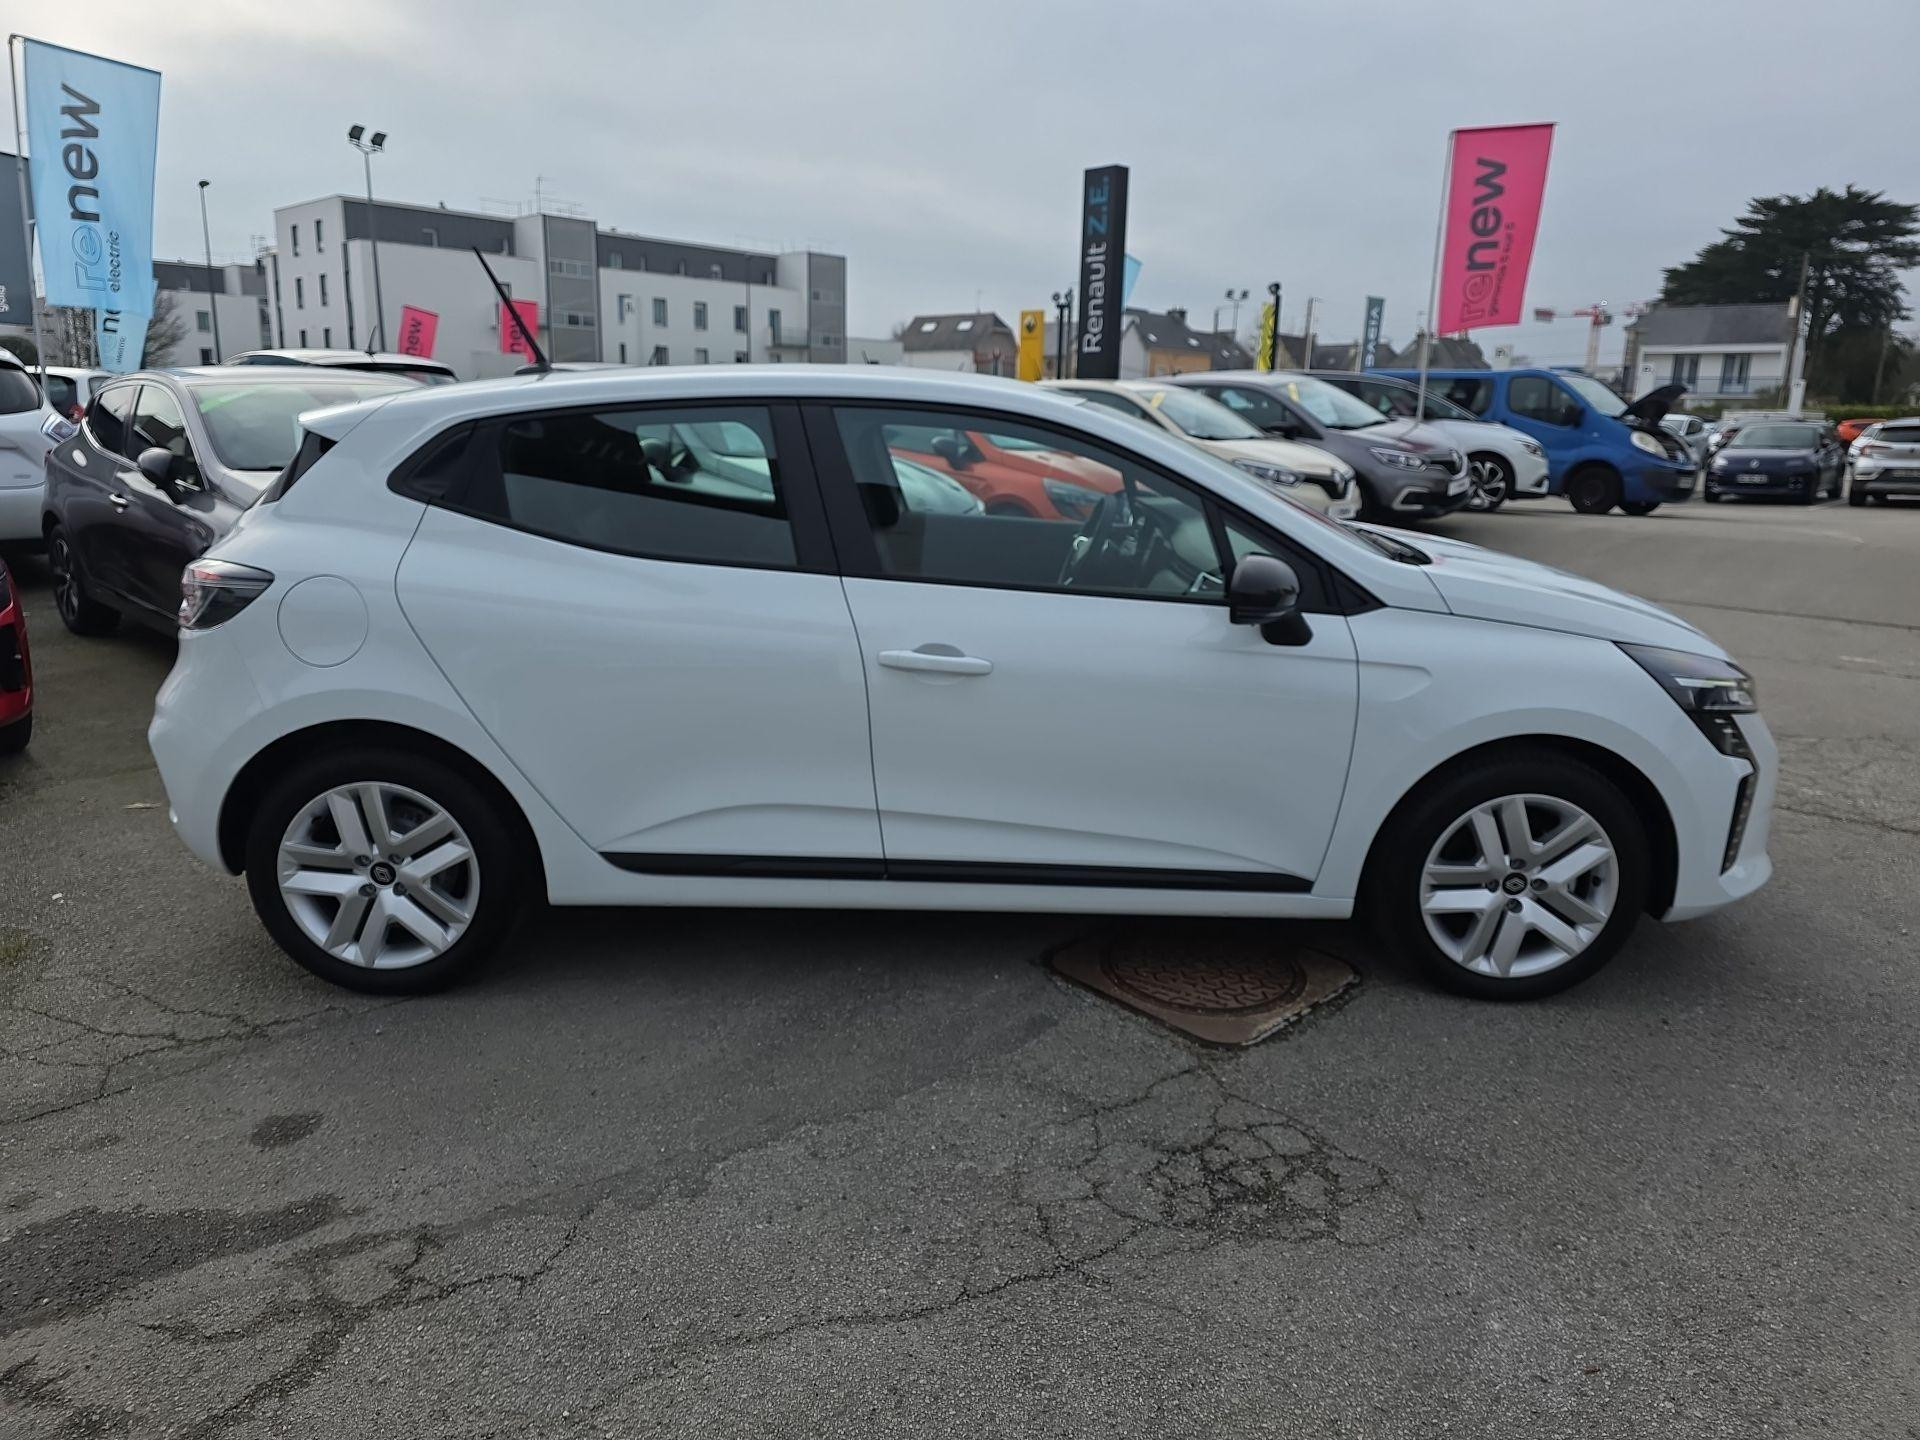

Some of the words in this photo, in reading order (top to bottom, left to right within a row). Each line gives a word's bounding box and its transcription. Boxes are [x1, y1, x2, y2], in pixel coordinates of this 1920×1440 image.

[60, 82, 106, 291] renew
[1088, 176, 1110, 236] Z.E.
[1461, 157, 1507, 323] renew
[106, 230, 121, 294] electric
[1082, 241, 1107, 354] Renault
